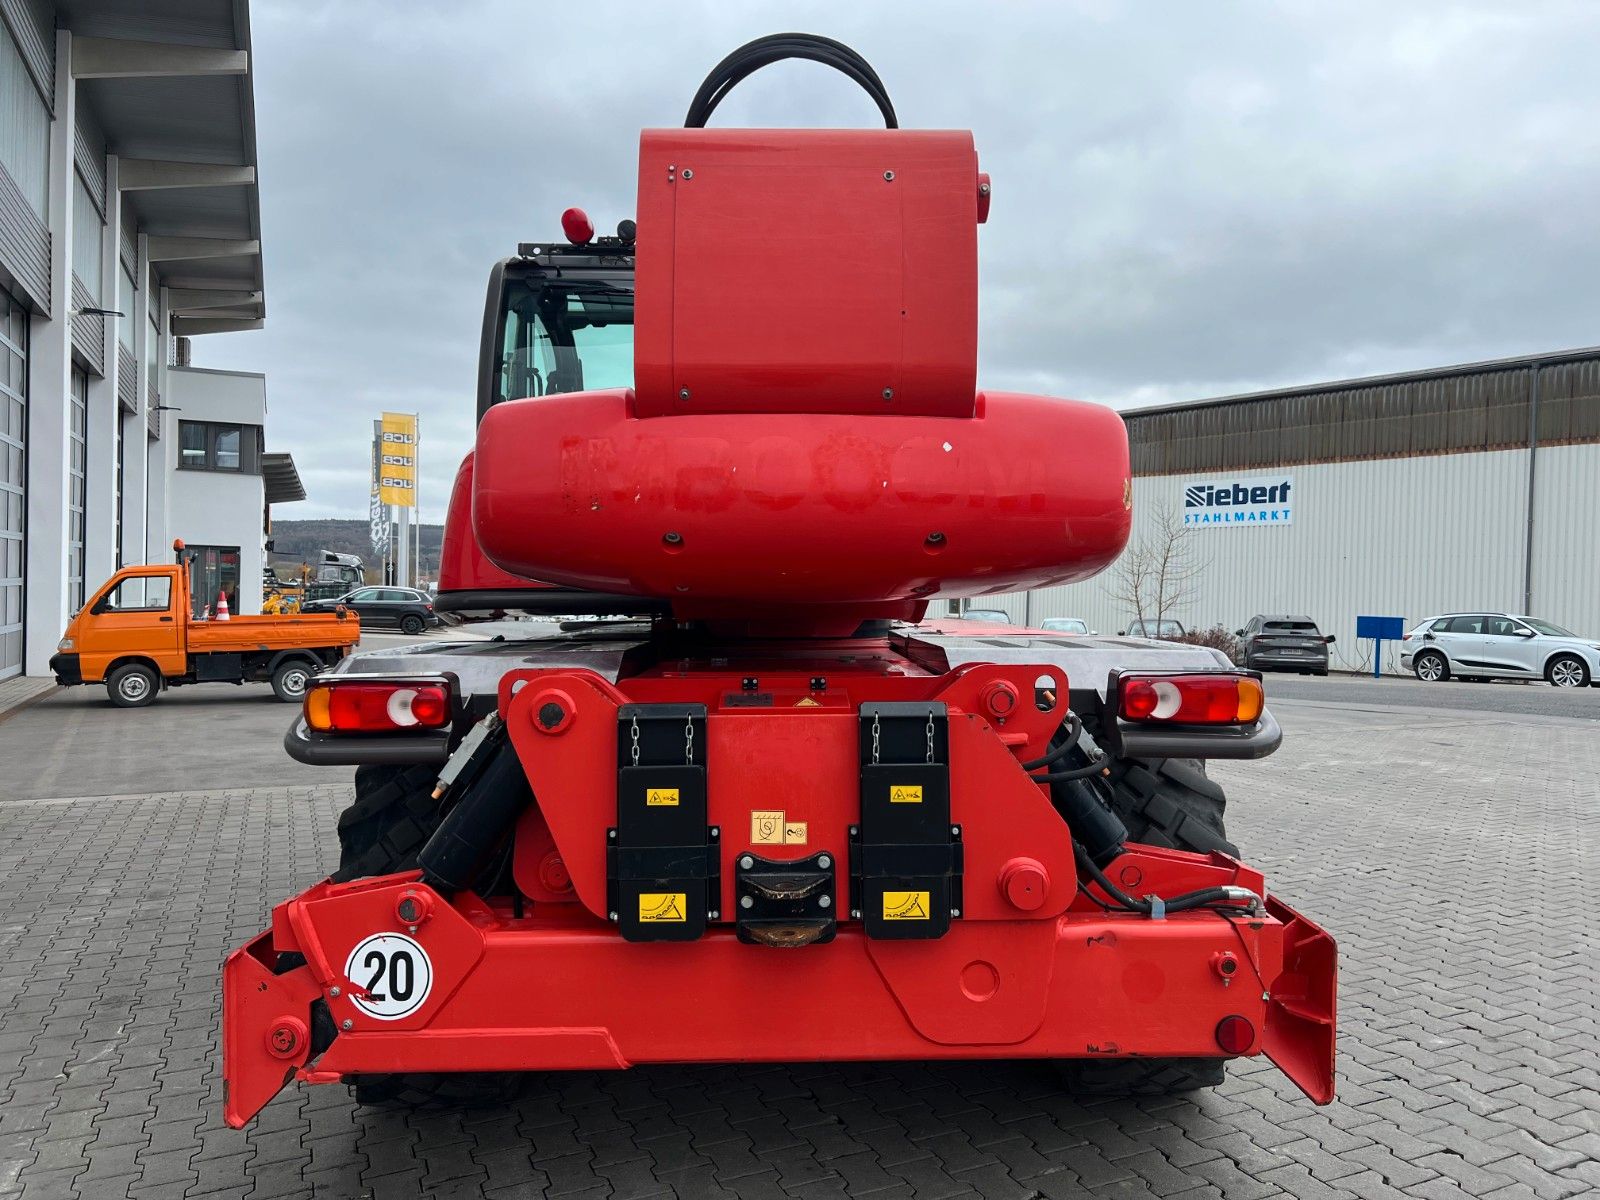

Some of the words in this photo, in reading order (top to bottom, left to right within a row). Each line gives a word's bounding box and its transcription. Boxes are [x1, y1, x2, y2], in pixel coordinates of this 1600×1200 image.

[1185, 481, 1291, 507] Siebert
[1185, 510, 1290, 524] STAHLMARKT
[364, 950, 414, 1001] 20
